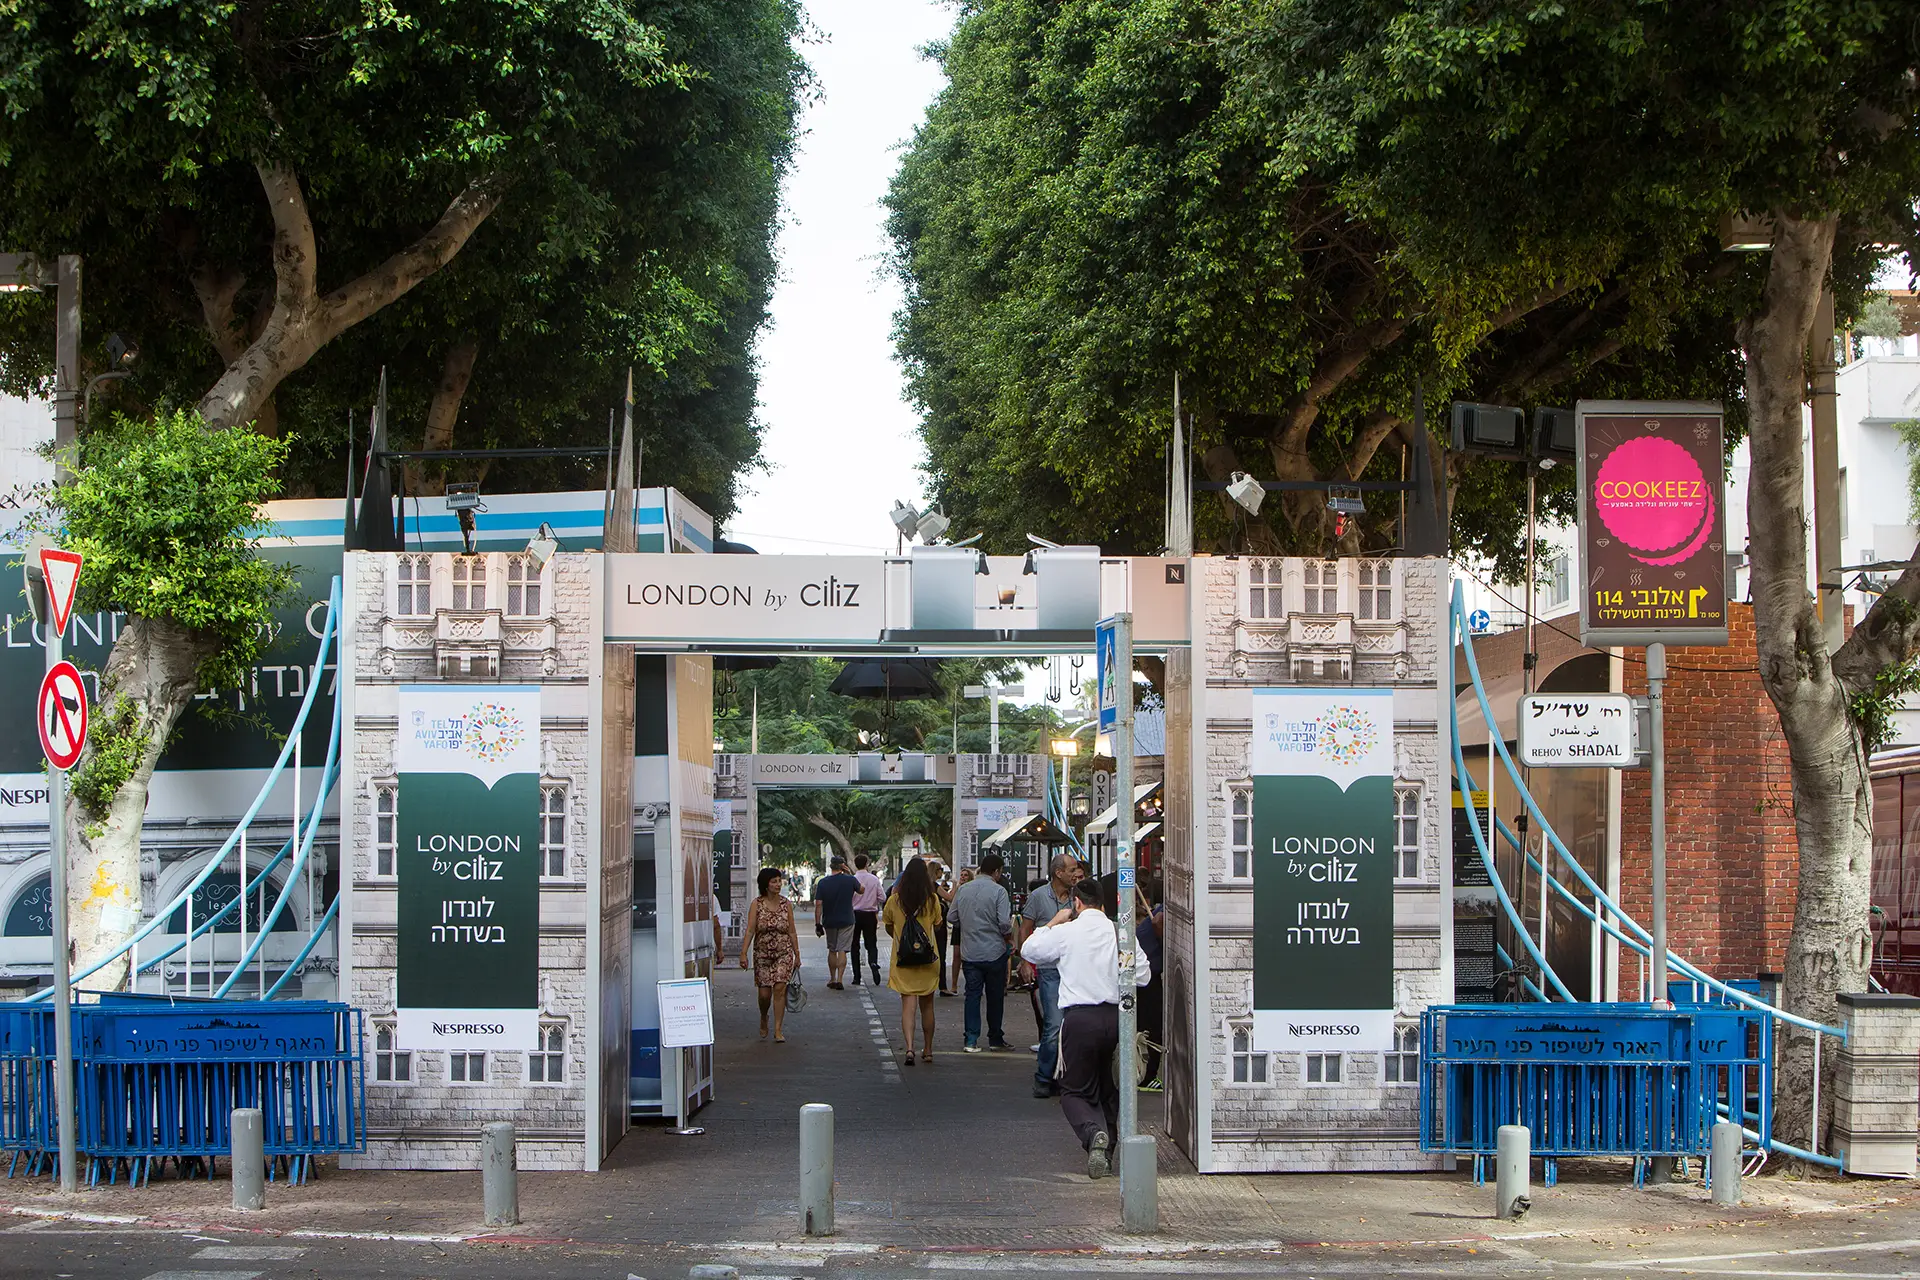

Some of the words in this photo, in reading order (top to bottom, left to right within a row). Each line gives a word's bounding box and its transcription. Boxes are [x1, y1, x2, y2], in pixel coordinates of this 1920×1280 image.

[1600, 481, 1702, 499] COOKEEZ
[627, 584, 752, 606] LONDON
[763, 588, 787, 611] by
[1596, 591, 1624, 606] 114
[1631, 586, 1685, 605] אלנבי
[1598, 607, 1651, 619] רוטשילד)
[1655, 608, 1685, 619] (פינת
[431, 720, 447, 729] TEL
[448, 718, 463, 729] תל
[1285, 723, 1302, 732] TEL
[1302, 721, 1317, 732] תל
[415, 730, 437, 739] AVIV
[438, 730, 463, 739] אביב
[1269, 733, 1292, 742] AVIV
[1292, 733, 1317, 742] אביב
[424, 740, 448, 749] YAFO
[448, 740, 463, 749] יפו
[1278, 743, 1302, 752] YAFO
[1302, 743, 1317, 752] יפו
[1531, 748, 1562, 757] REHOV
[1568, 744, 1622, 757] SHADAL
[760, 764, 805, 773] LONDON
[808, 765, 817, 775] by
[417, 835, 520, 852] LONDON
[1272, 837, 1374, 854] LONDON
[432, 857, 452, 875] by
[1287, 859, 1307, 877] by
[442, 896, 495, 924] לונדון
[1297, 898, 1350, 925] לונדון
[431, 926, 506, 943] בשדרה
[1287, 928, 1361, 945] בשדרה
[430, 1021, 505, 1037] NESPRESSO
[1287, 1022, 1361, 1038] NESPRESSO
[126, 1038, 170, 1054] העיר
[174, 1038, 200, 1053] פני
[207, 1034, 269, 1052] לשיפור
[274, 1036, 326, 1054] האגף
[1452, 1039, 1497, 1055] העיר
[1505, 1040, 1533, 1054] פני
[1539, 1038, 1605, 1054] לשיפור
[1612, 1039, 1662, 1055] האגף
